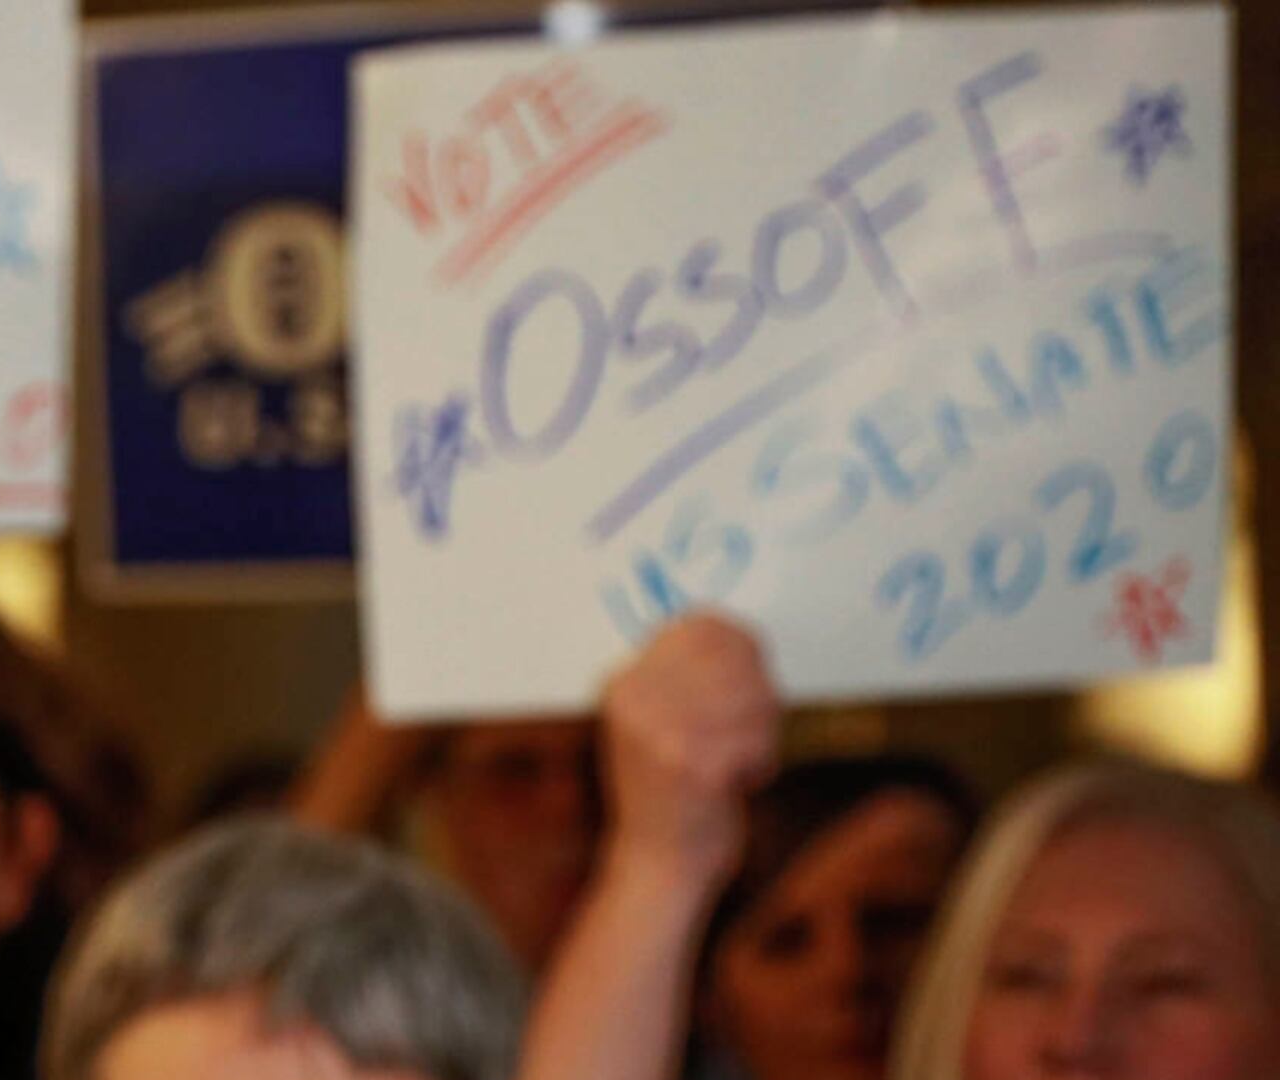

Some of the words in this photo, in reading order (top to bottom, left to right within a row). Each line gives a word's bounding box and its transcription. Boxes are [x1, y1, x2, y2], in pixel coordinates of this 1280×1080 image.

[387, 60, 598, 236] VOTE
[752, 245, 1230, 550] SENATE
[876, 408, 1218, 664] 2020
